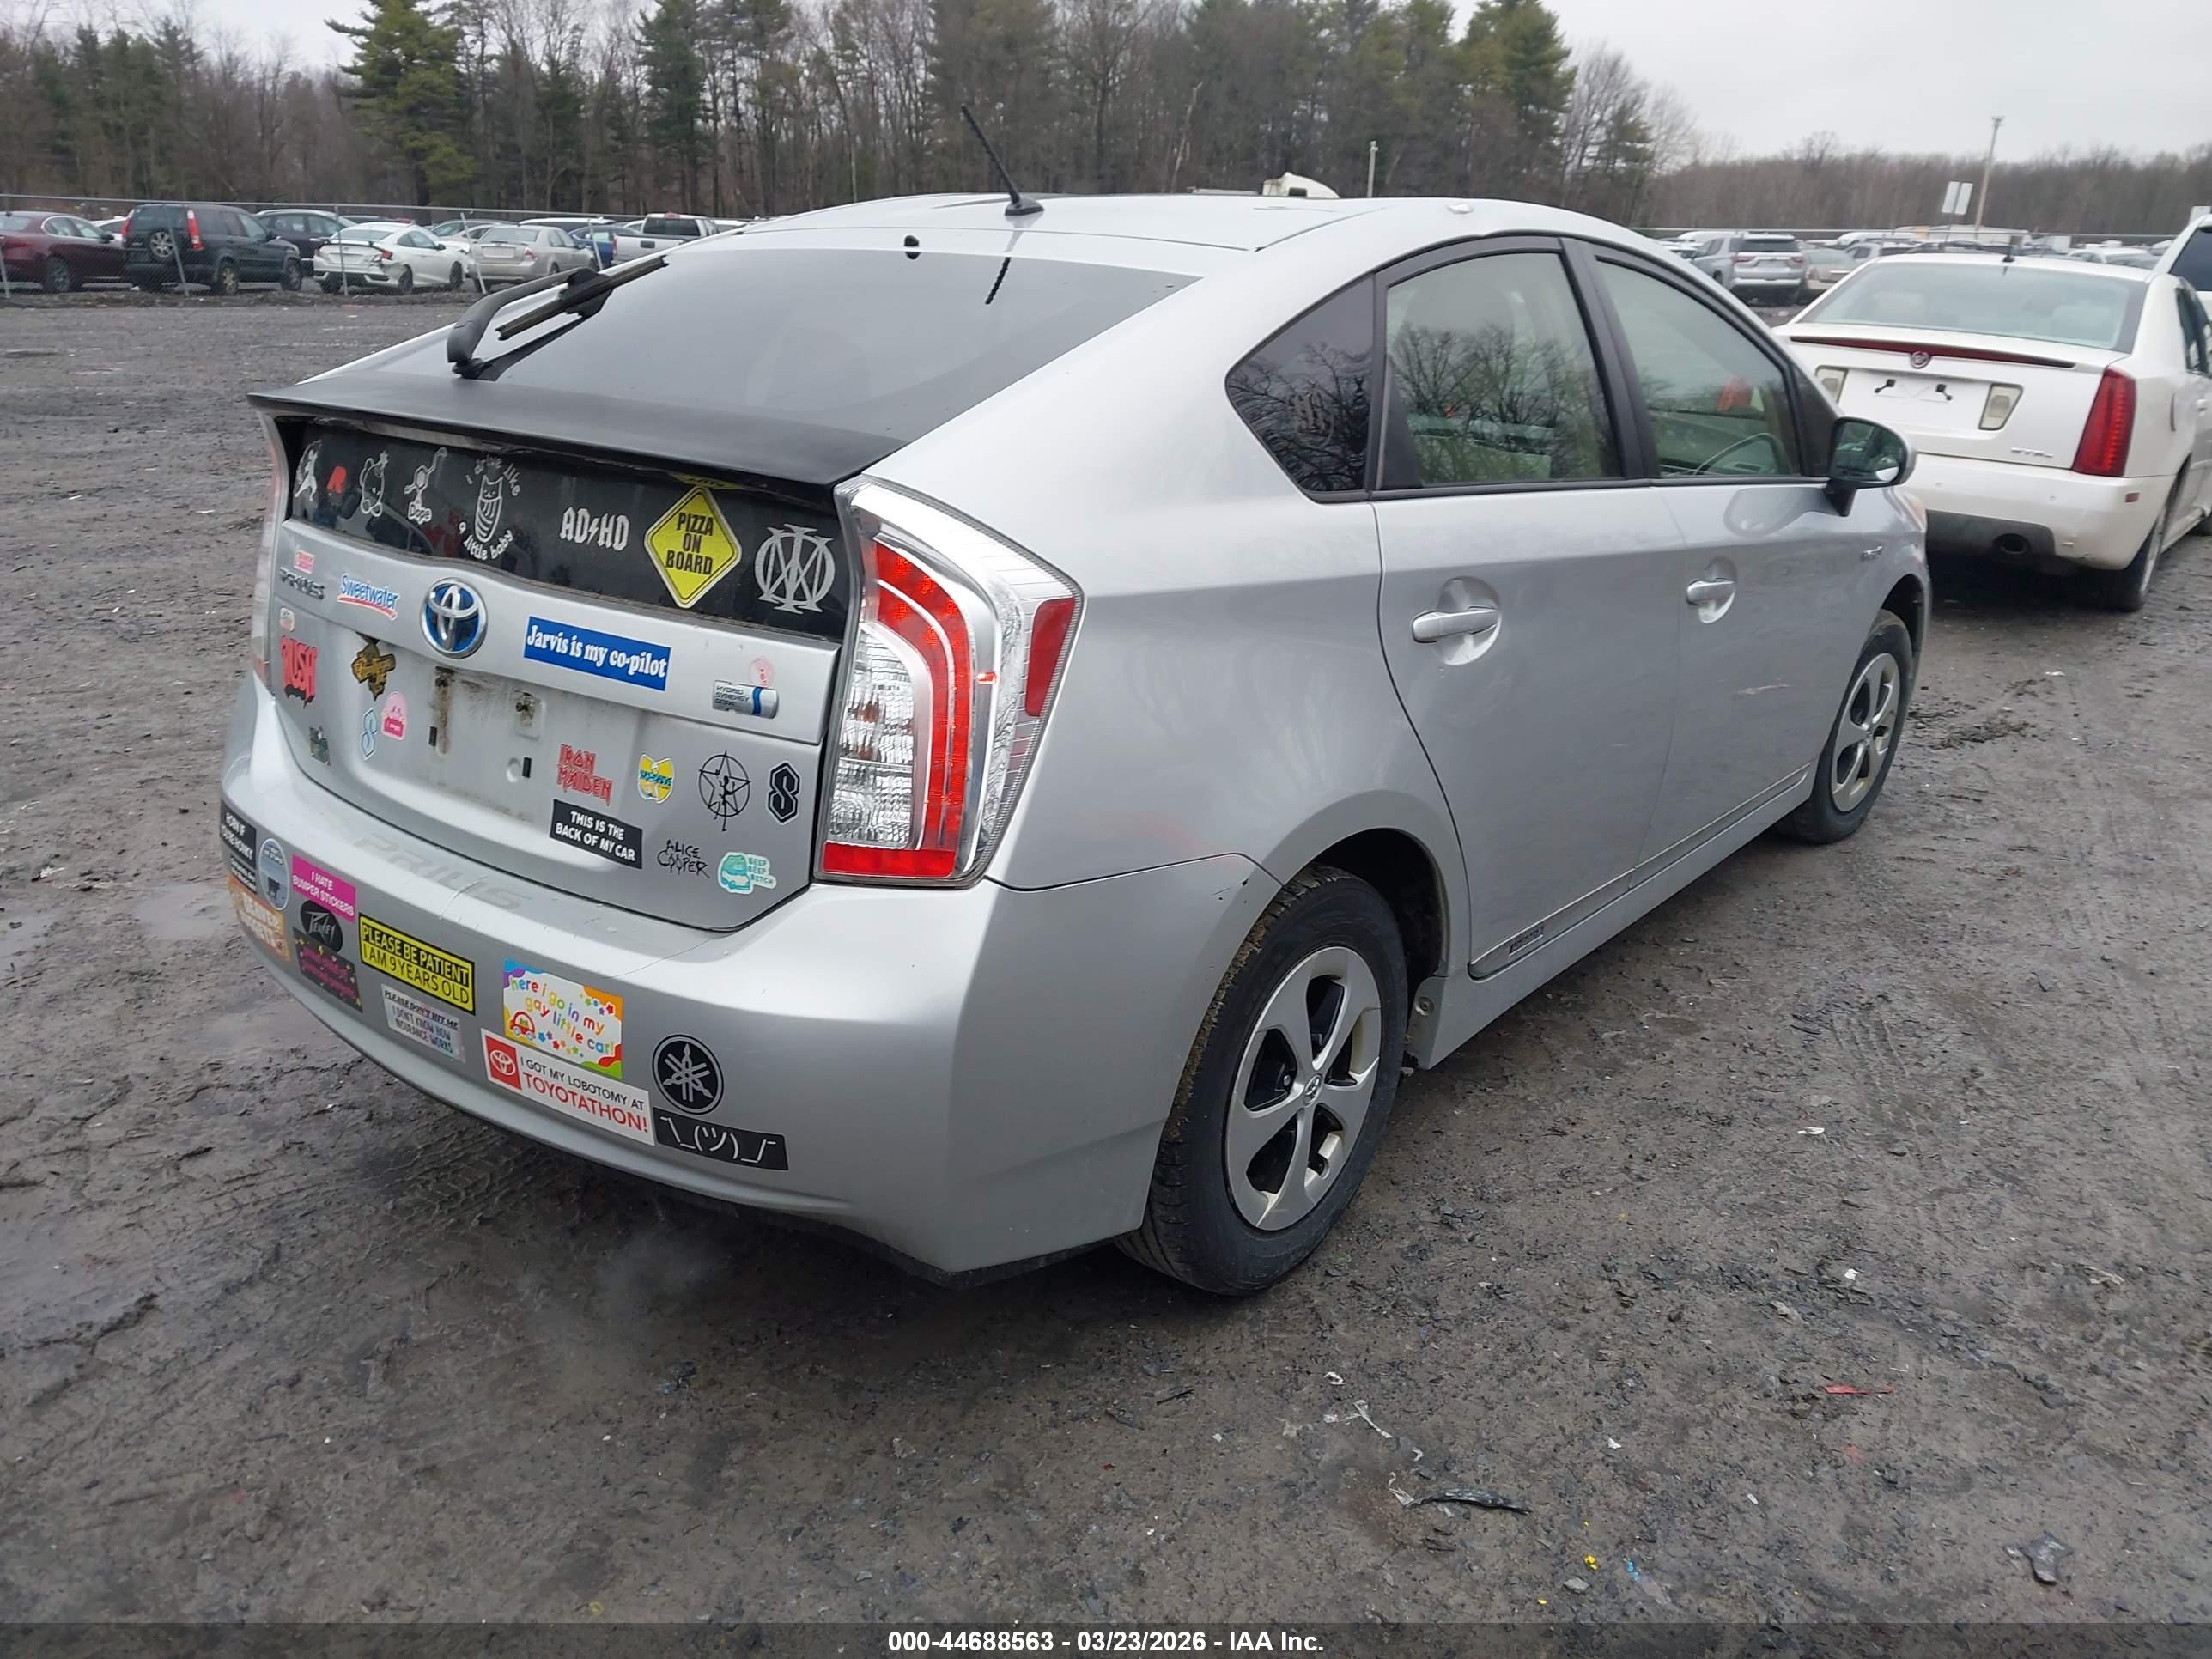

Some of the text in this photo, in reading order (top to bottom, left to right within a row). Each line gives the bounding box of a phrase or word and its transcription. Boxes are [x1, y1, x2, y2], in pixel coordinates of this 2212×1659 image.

[503, 463, 520, 496] like
[677, 512, 713, 537] PIZZA
[464, 534, 488, 560] little
[489, 530, 514, 559] baby
[683, 532, 702, 554] ON
[665, 549, 713, 576] BOARD
[342, 574, 399, 610] Sweetwater
[527, 625, 667, 678] Jarvis is my co-pilot
[559, 744, 596, 771] IRON
[557, 764, 613, 806] MAIDEN
[555, 823, 635, 861] BACK OF MY CAR
[570, 811, 624, 841] THIS IS THE
[657, 850, 711, 878] COOPER
[665, 839, 701, 860] ALICE
[293, 874, 354, 916] BUMPER STICKERS
[311, 871, 334, 890] I HATE
[362, 924, 470, 988] PLEASE BE PATIENT
[363, 943, 368, 959] I
[369, 946, 386, 969] AM
[389, 955, 396, 971] 9
[396, 958, 440, 993] YEARS
[441, 979, 470, 1004] OLD
[509, 976, 605, 1036] here i go in my
[525, 996, 615, 1055] gay little car!
[520, 1056, 646, 1111] I GOT MY LOBOTOMY AT
[523, 1072, 649, 1133] TOYOTATHON!
